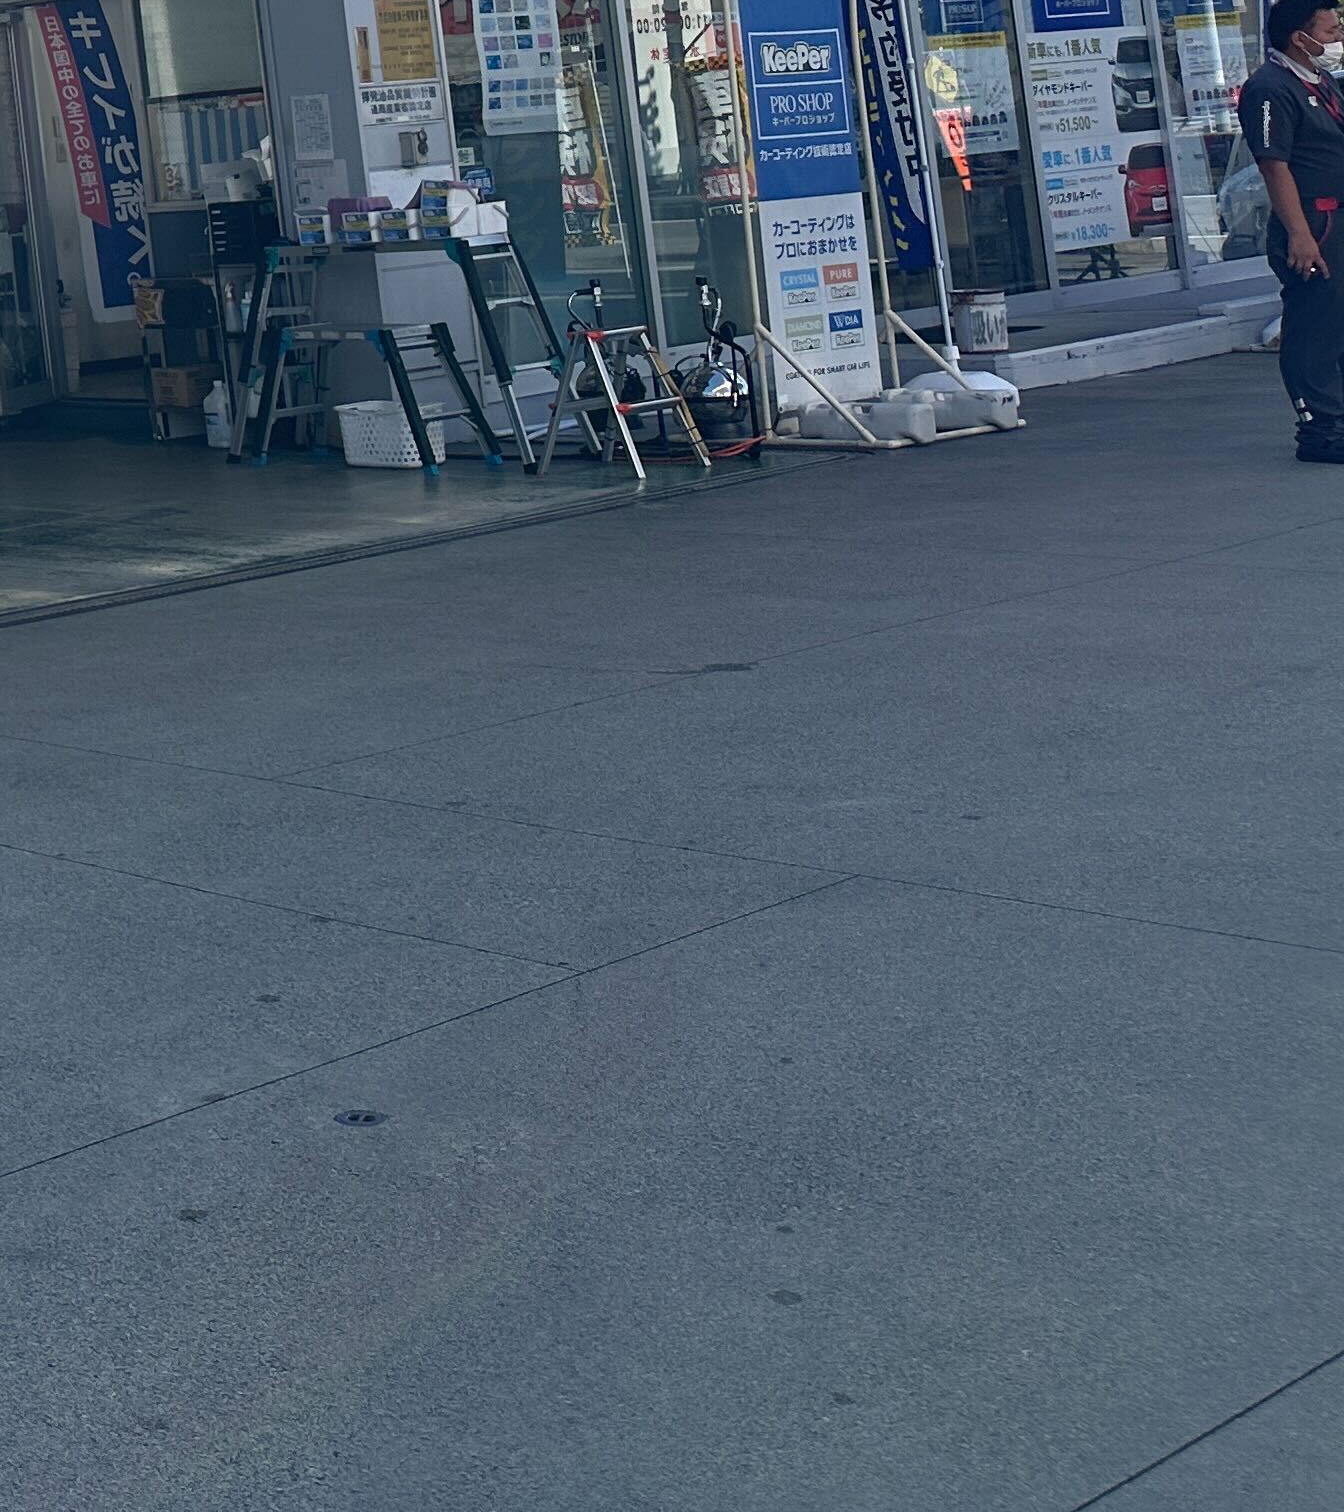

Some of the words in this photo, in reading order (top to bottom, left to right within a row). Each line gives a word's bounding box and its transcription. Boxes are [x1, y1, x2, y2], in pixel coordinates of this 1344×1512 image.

[761, 42, 831, 75] KeePer
[770, 94, 797, 114] PRO
[798, 92, 833, 112] SHOP
[772, 112, 835, 127] キーパープロショップ
[772, 213, 855, 237] カーコーティングは
[774, 236, 858, 260] プロにおまかせを
[783, 272, 816, 286] CRYSTAL
[829, 267, 853, 281] PURE
